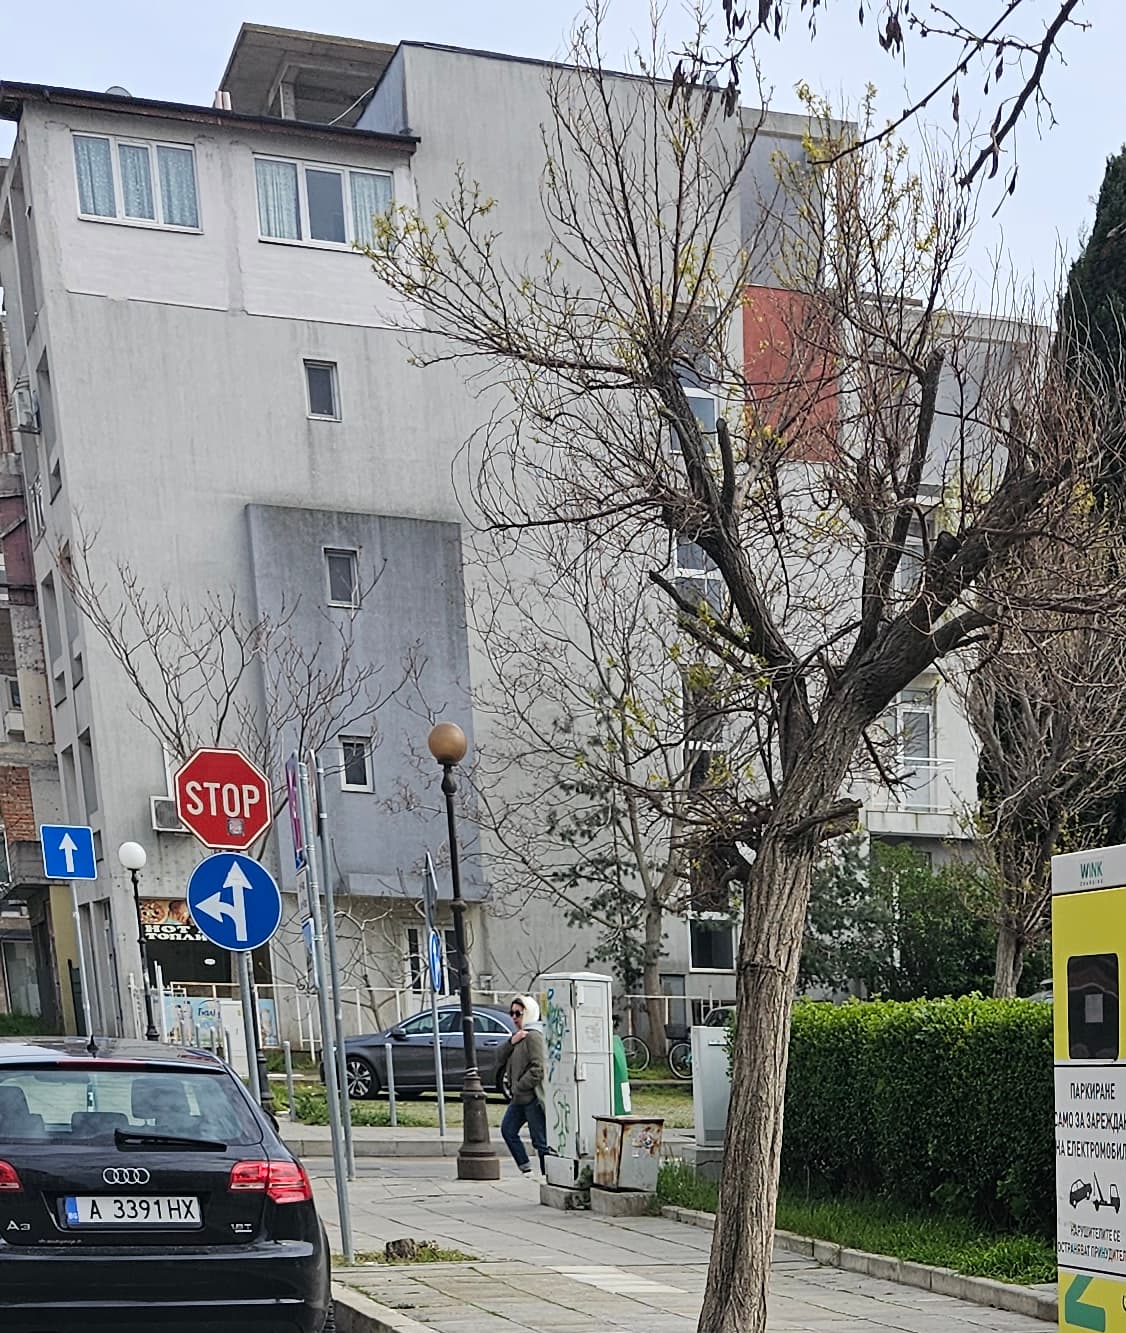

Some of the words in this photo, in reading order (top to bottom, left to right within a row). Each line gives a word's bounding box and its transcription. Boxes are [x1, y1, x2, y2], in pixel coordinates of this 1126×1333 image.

[185, 781, 260, 818] STOP
[1080, 861, 1103, 878] WINK
[145, 925, 191, 933] HOT
[1070, 1083, 1115, 1099] ПАРКИРАНЕ
[1075, 1112, 1085, 1128] ЗА
[90, 1200, 102, 1219] A
[6, 1220, 31, 1231] A3
